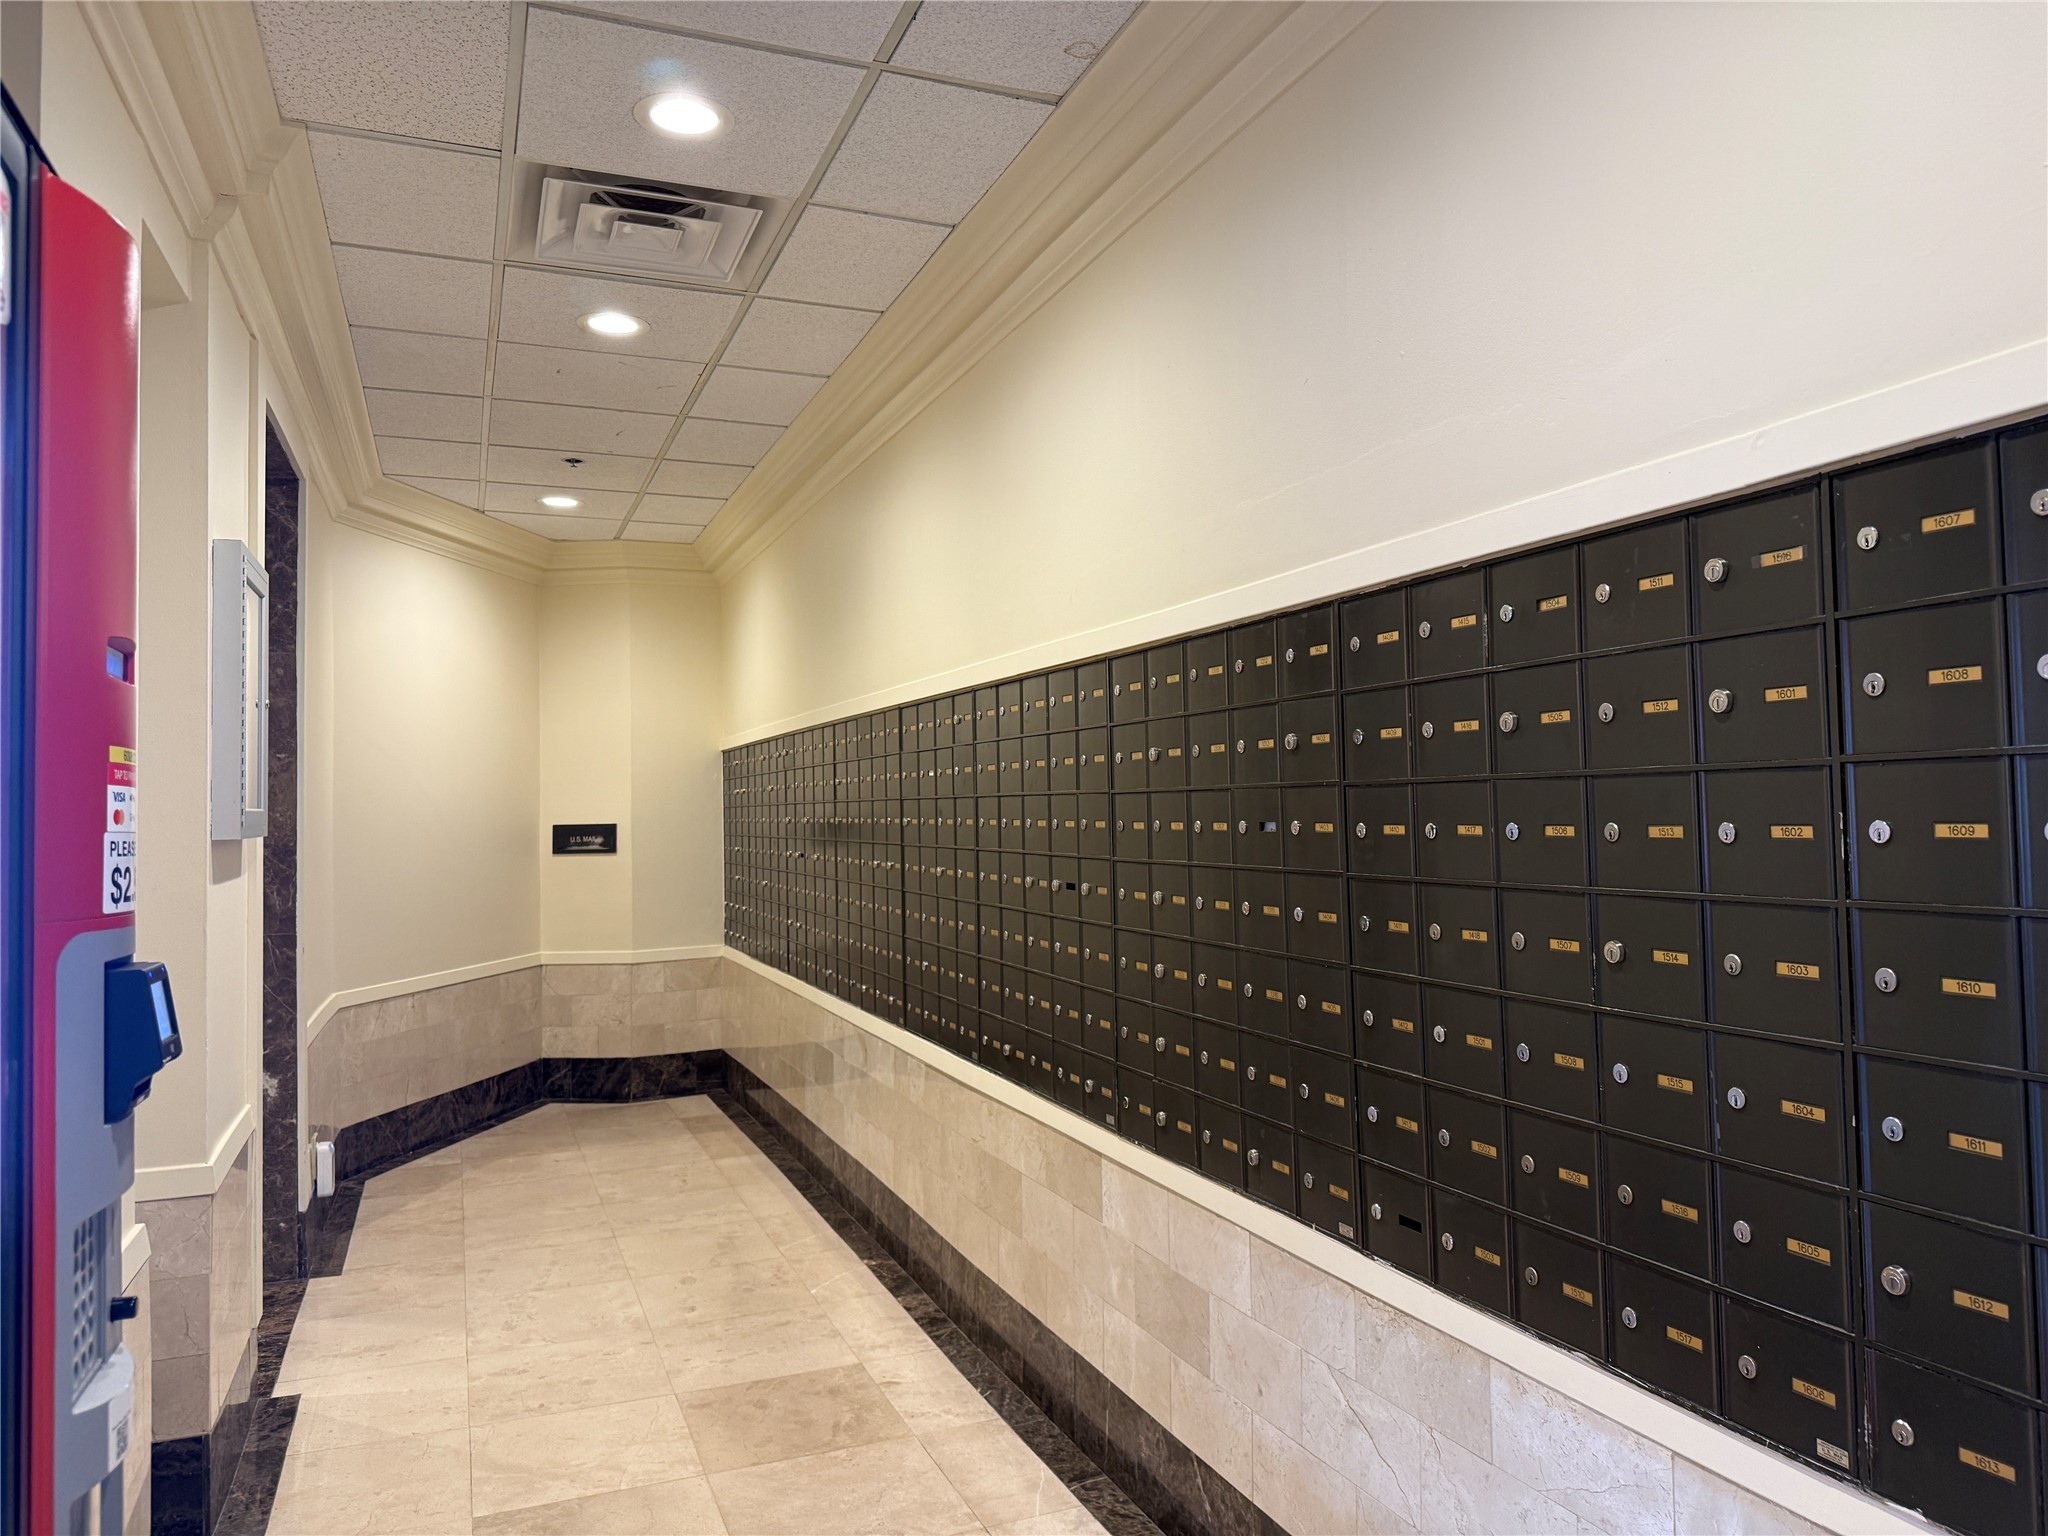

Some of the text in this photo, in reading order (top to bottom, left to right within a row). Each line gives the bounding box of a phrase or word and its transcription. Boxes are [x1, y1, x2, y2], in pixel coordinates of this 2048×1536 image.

[1933, 512, 1961, 528] 1607
[1649, 576, 1663, 588] 1511
[1544, 598, 1561, 608] 1504
[1457, 616, 1471, 626] 1415
[1382, 632, 1394, 643] 1408
[1941, 668, 1969, 681] 1608
[1775, 688, 1796, 700] 1601
[1652, 701, 1670, 712] 1512
[1547, 712, 1564, 722] 1505
[1460, 721, 1473, 730] 1416
[1385, 728, 1398, 737] 1409
[112, 791, 126, 802] VISA
[1464, 826, 1477, 834] 1417
[1551, 826, 1568, 836] 1506
[1657, 827, 1675, 838] 1513
[1780, 826, 1804, 837] 1602
[1947, 824, 1976, 837] 1609
[1468, 931, 1481, 940] 1418
[1556, 940, 1573, 950] 1507
[1662, 952, 1679, 963] 1514
[1786, 964, 1809, 976] 1603
[1956, 981, 1982, 994] 1610
[1397, 1020, 1409, 1030] 1412
[1472, 1037, 1486, 1047] 1501
[1560, 1055, 1577, 1067] 1508
[1666, 1077, 1684, 1089] 1515
[1792, 1104, 1815, 1118] 1604
[1476, 1143, 1491, 1155] 1502
[1965, 1138, 1986, 1153] 1611
[1565, 1170, 1581, 1183] 1509
[1671, 1204, 1689, 1217] 1516
[1480, 1249, 1495, 1263] 1503
[1796, 1242, 1821, 1258] 1605
[1570, 1287, 1586, 1300] 1510
[1968, 1296, 1994, 1314] 1612
[1676, 1331, 1693, 1345] 1517
[1802, 1383, 1826, 1401] 1606
[1974, 1455, 2001, 1474] 1613
